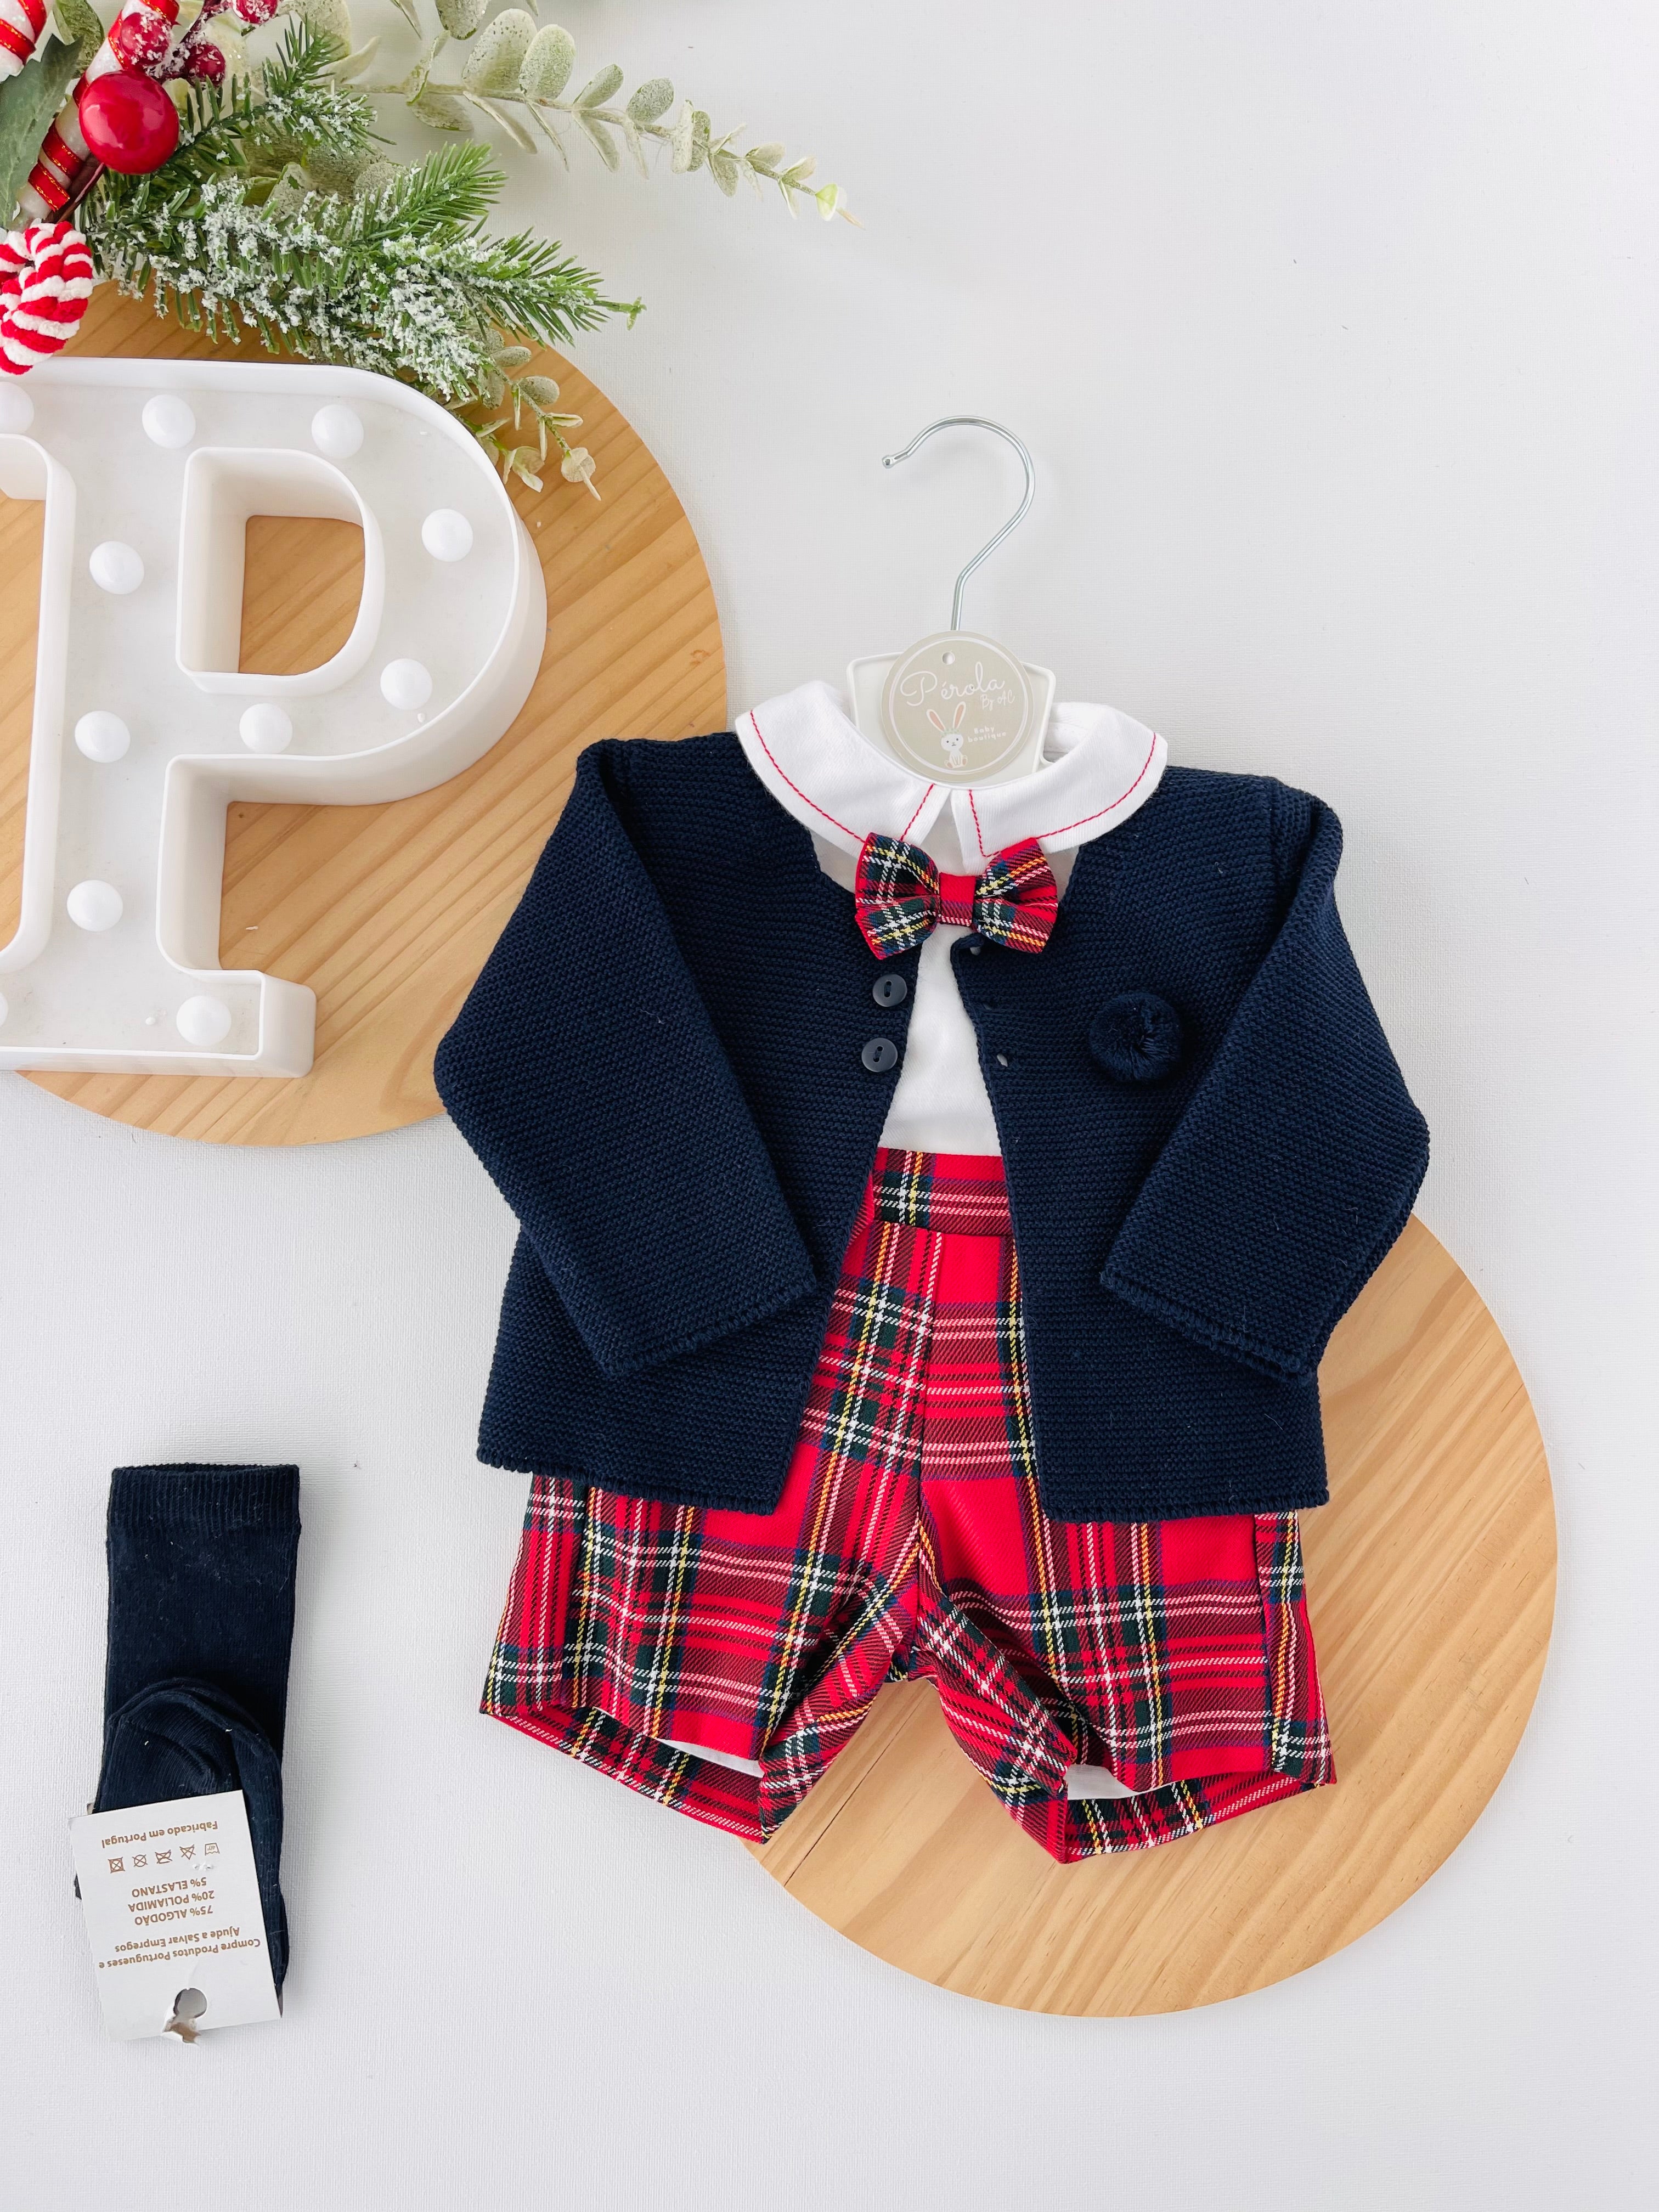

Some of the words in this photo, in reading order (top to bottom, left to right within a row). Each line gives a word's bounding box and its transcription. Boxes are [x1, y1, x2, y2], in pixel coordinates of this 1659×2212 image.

[900, 662, 1005, 706] Pérola
[980, 693, 994, 710] By
[0, 357, 546, 1077] P
[968, 732, 1007, 742] boutique
[974, 726, 995, 735] Baby
[149, 1829, 165, 1837] em
[167, 1821, 218, 1835] Fabricado
[101, 1832, 146, 1848] Portugal
[190, 1877, 207, 1887] 5%
[132, 1881, 188, 1897] ELASTANO
[191, 1891, 215, 1901] 20%
[128, 1894, 189, 1912] POLIAMIDA
[190, 1905, 213, 1916] 75%
[135, 1909, 187, 1926] ALGODÃO
[168, 1933, 199, 1944] Salvar
[210, 1927, 240, 1939] Ajude
[114, 1938, 166, 1953] Empregos
[173, 1944, 219, 1957] Produtos
[220, 1939, 261, 1951] Compre
[108, 1951, 171, 1968] Portugueses
